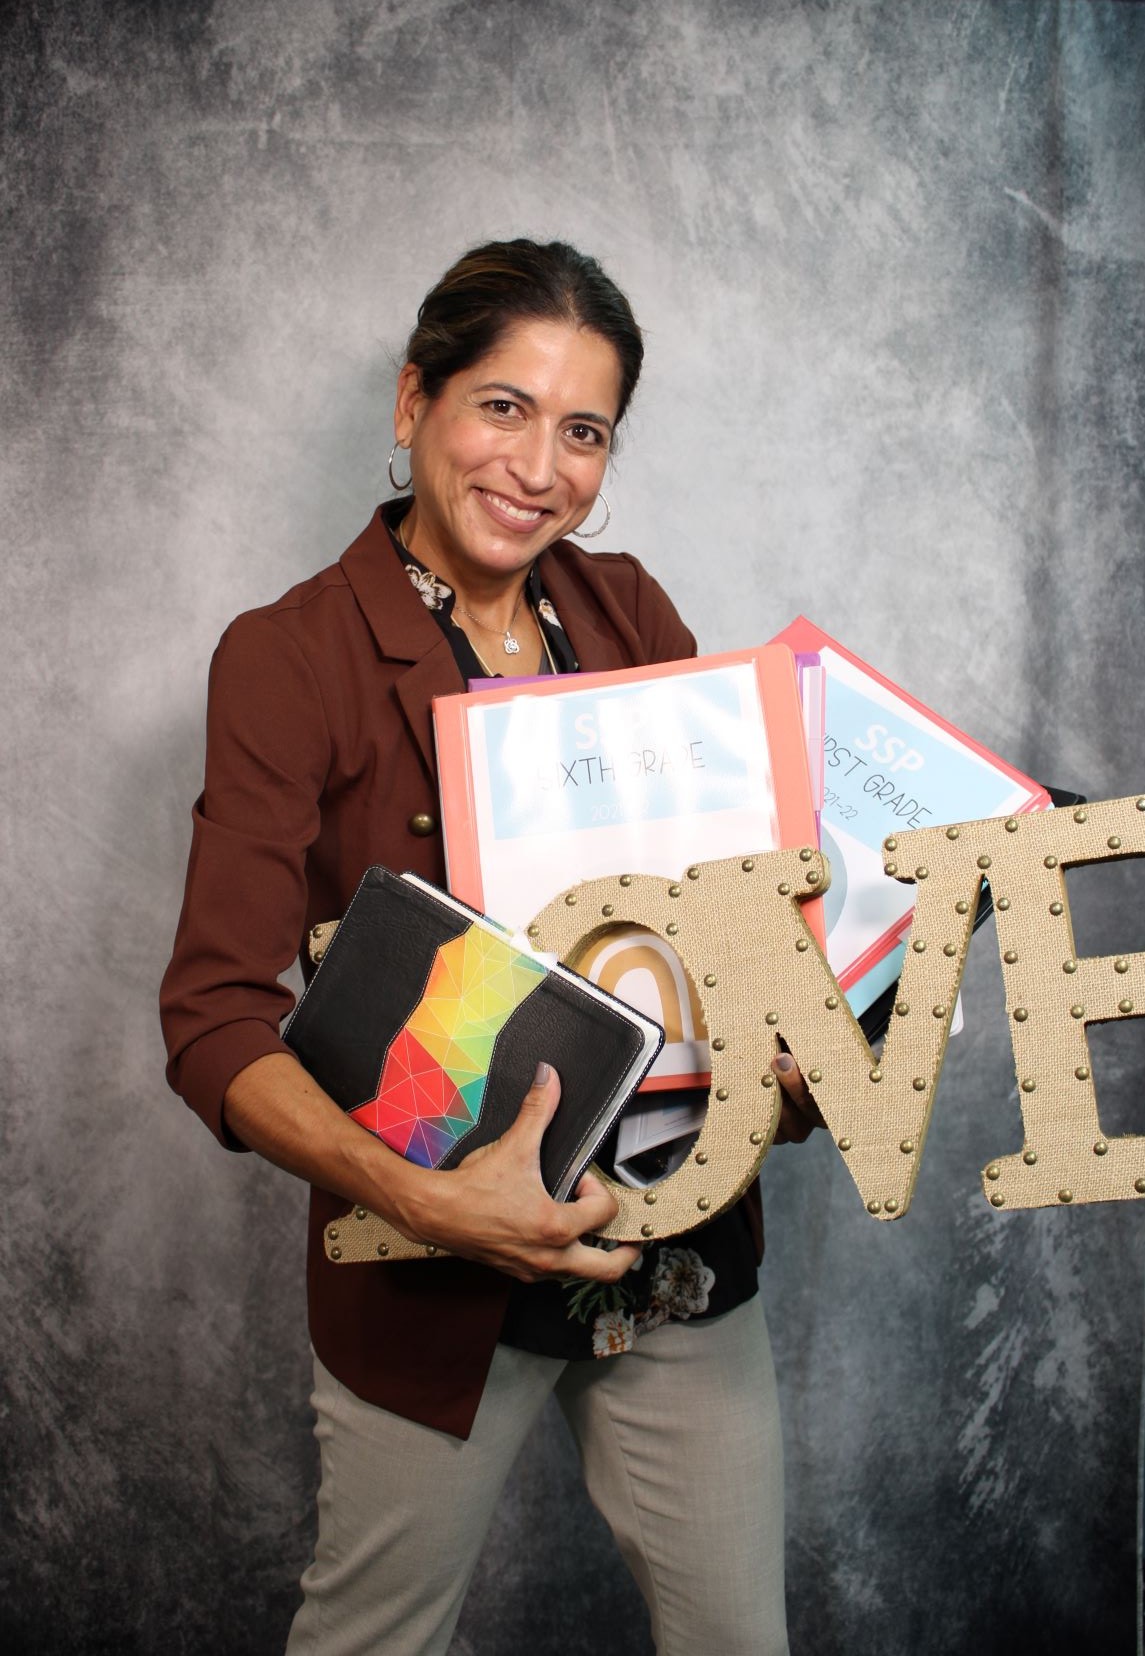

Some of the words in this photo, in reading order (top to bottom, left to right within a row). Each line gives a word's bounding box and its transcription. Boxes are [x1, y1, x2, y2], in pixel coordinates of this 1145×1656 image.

[854, 723, 925, 772] SSP
[863, 774, 933, 829] GRADE
[308, 796, 1145, 1263] OVE
